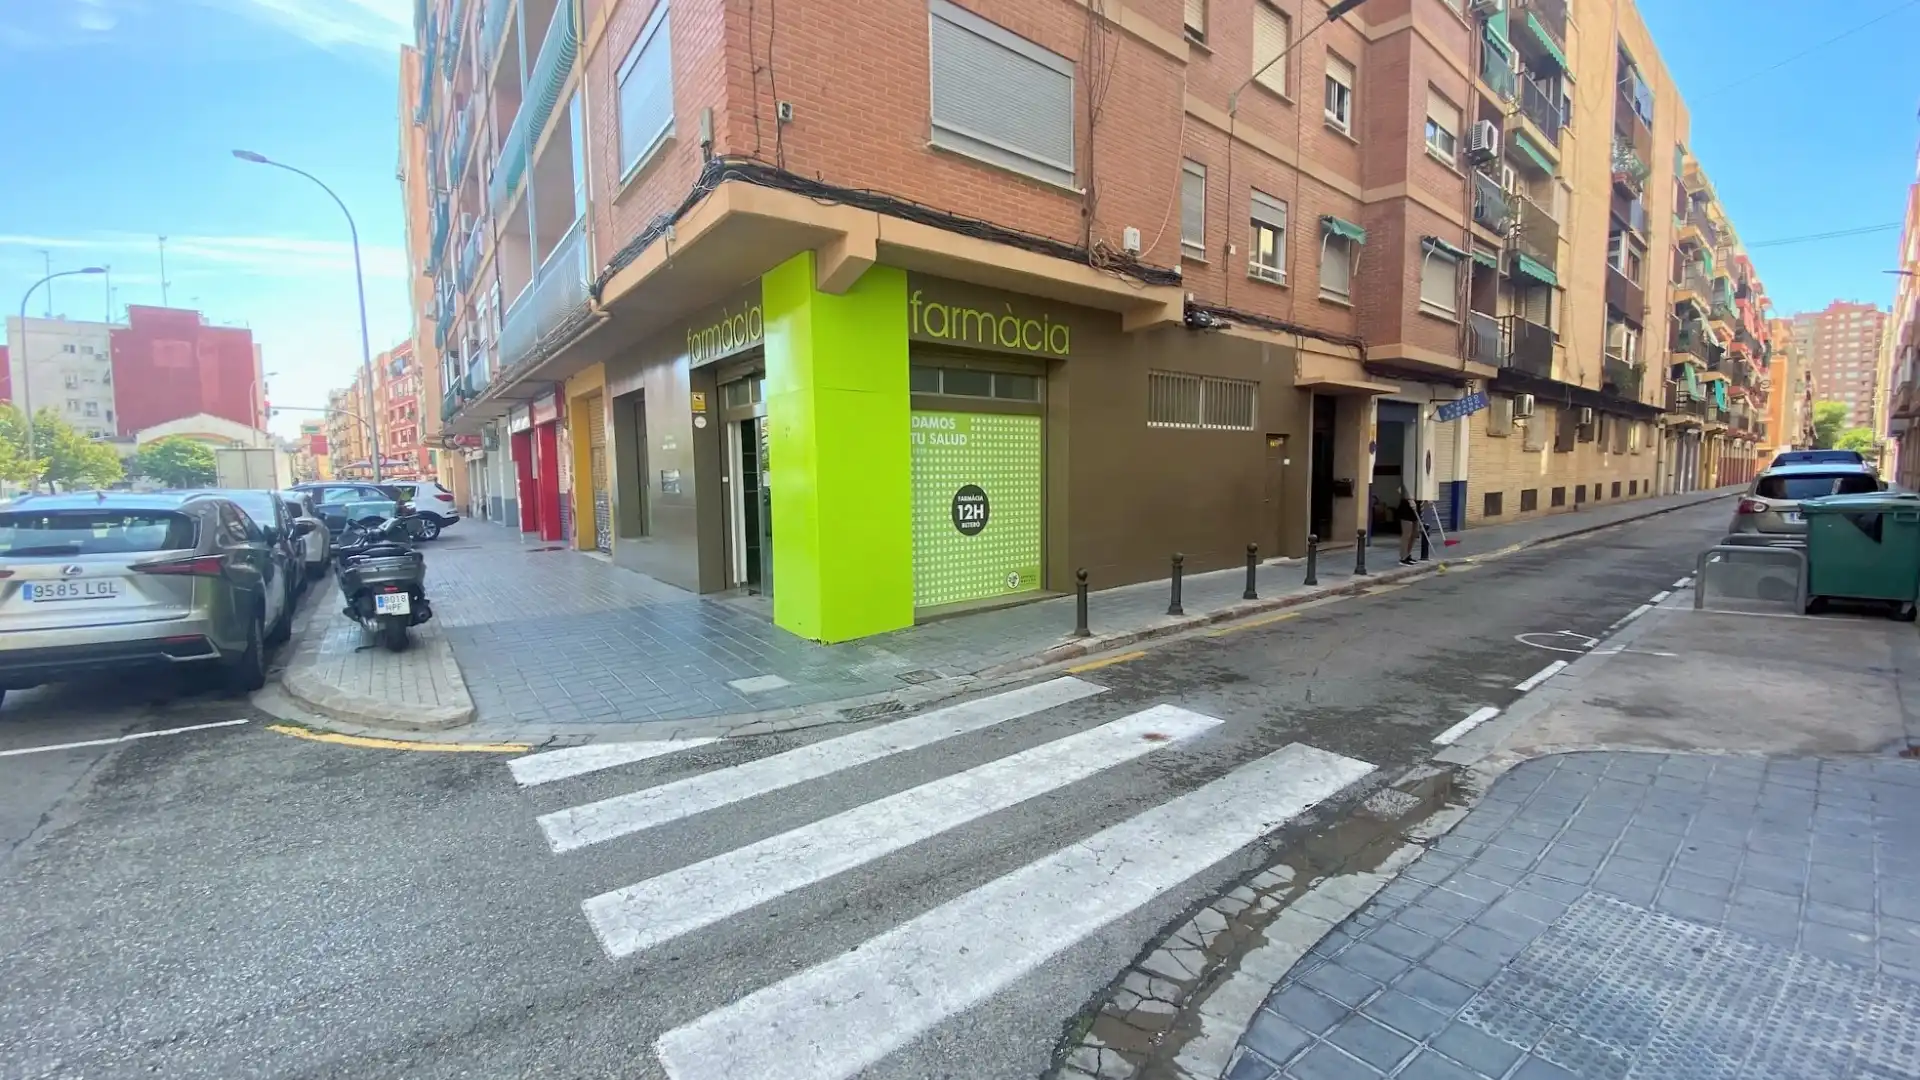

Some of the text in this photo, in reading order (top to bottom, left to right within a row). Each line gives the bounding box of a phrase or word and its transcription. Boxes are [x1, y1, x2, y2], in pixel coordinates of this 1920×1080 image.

[910, 290, 1069, 354] farmàcia
[687, 300, 763, 364] farmàcia
[911, 416, 956, 430] DAMOS
[910, 432, 968, 446] TU SALUD
[957, 504, 984, 520] 12H
[34, 581, 119, 598] 9585 LGL
